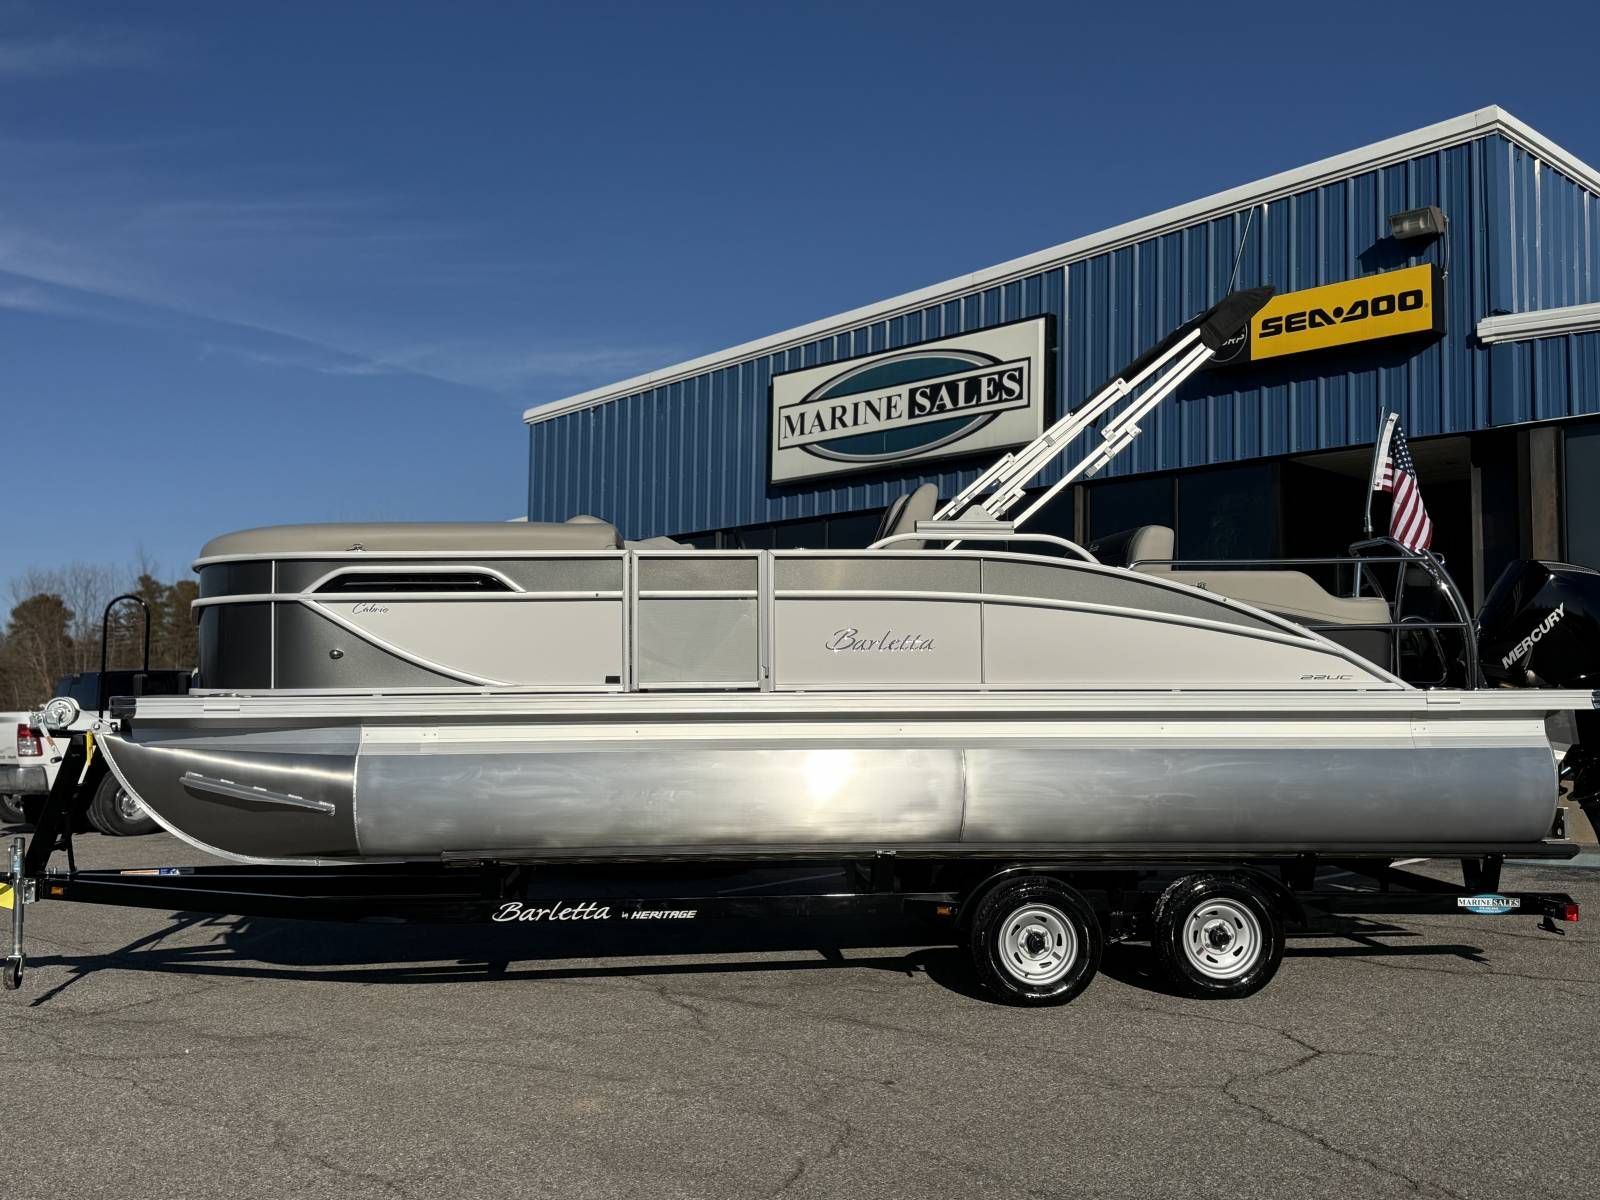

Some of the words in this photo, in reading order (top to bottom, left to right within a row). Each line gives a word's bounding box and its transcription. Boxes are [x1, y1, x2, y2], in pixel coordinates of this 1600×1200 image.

[782, 393, 903, 439] MARINE
[914, 371, 1021, 416] SALES
[825, 628, 935, 652] Barletta
[1501, 601, 1565, 670] MERCURY
[491, 900, 612, 922] Barletta
[630, 910, 698, 920] HERITAGE
[1493, 899, 1520, 907] SALES
